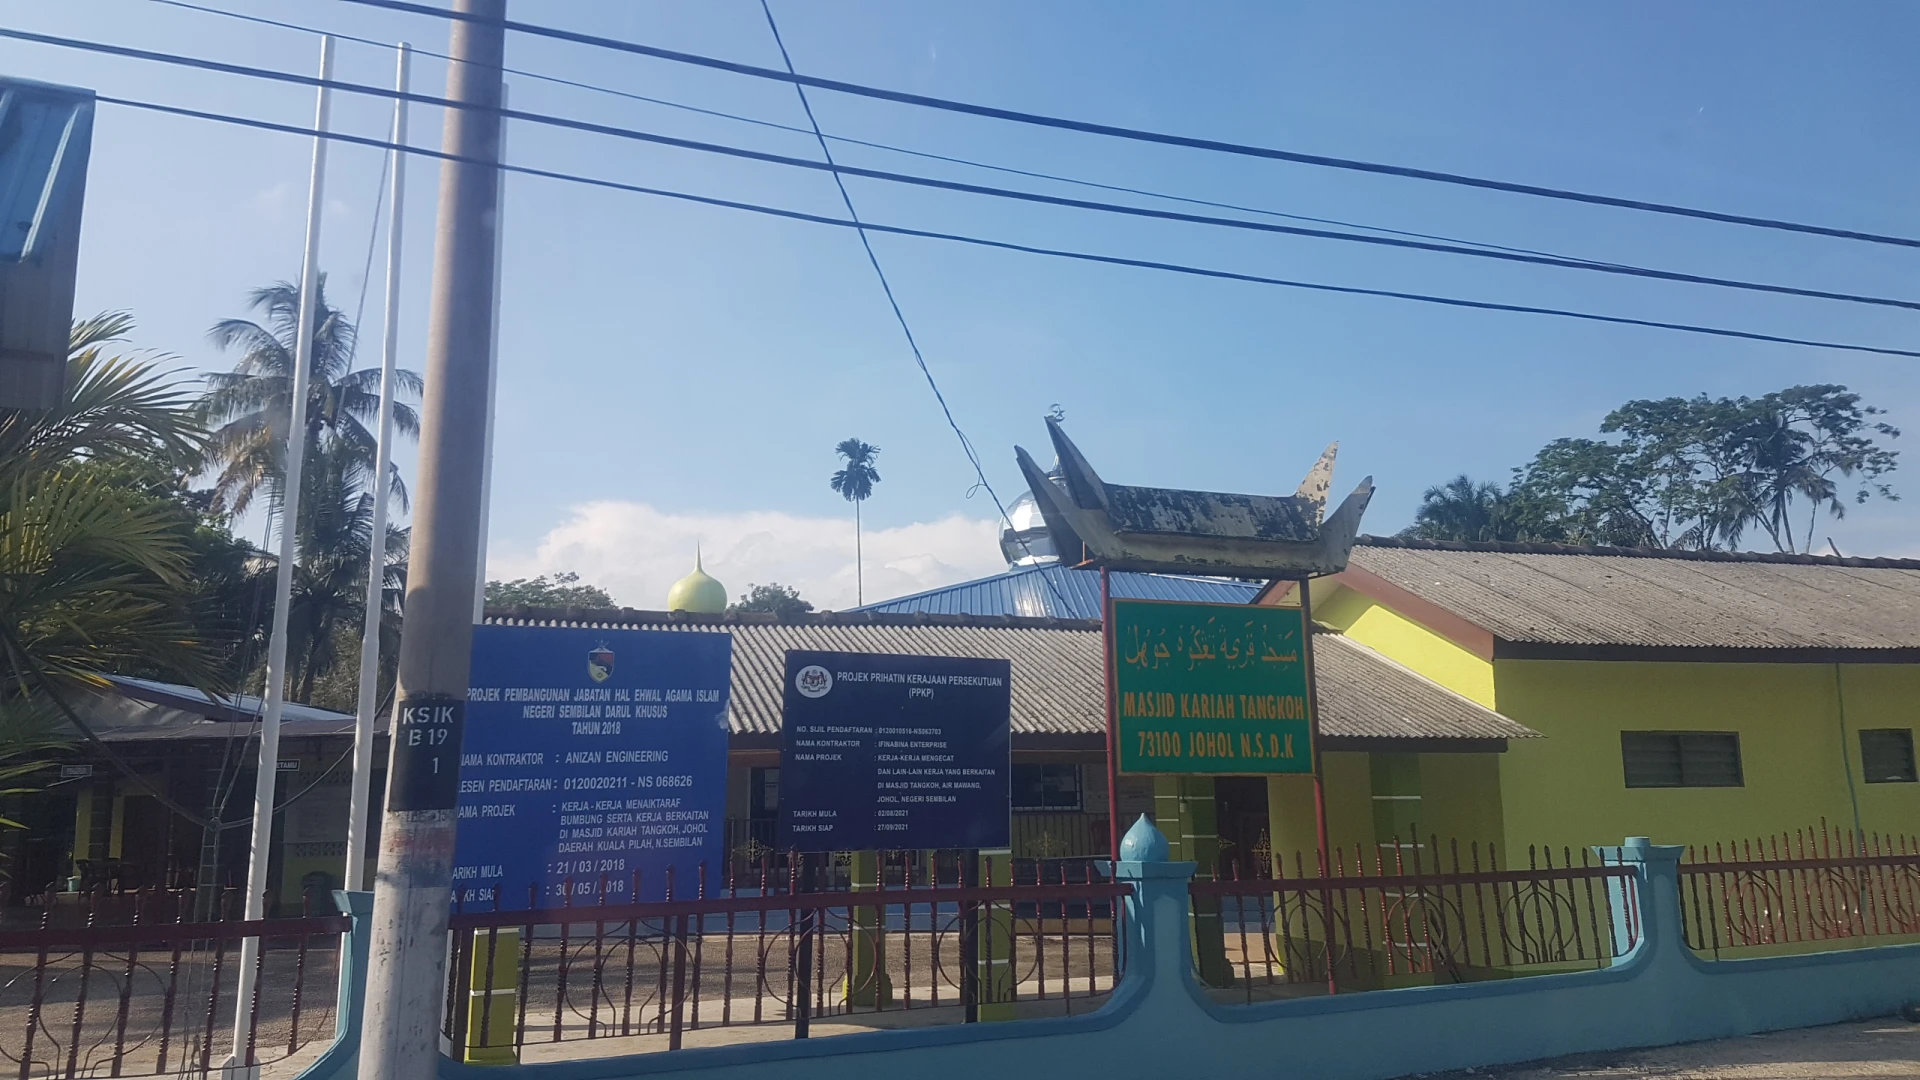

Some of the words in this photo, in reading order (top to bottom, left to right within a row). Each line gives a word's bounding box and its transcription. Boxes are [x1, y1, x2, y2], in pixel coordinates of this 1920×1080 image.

[837, 671, 869, 682] PROJEK
[870, 672, 905, 683] PRIHATIN
[907, 674, 947, 685] KERAJAAN
[949, 675, 1002, 687] PERSEKUTUAN
[504, 688, 570, 701] PEMBANGUNAN
[574, 688, 611, 701] JABATAN
[614, 688, 631, 702] HAL
[634, 689, 661, 702] EHWAL
[665, 690, 693, 702] AGAMA
[696, 690, 720, 702] ISLAM
[908, 688, 934, 700] (PPKP)
[523, 705, 555, 718] NEGERI
[558, 705, 601, 718] SEMBILAN
[605, 705, 631, 718] DARUL
[636, 705, 668, 718] KHUSUS
[1124, 691, 1175, 718] MASJID
[1180, 692, 1235, 719] KARIAH
[1240, 694, 1305, 720] TANGKOH
[572, 722, 600, 735] TAHUN
[602, 722, 621, 735] 2018
[1138, 731, 1181, 757] 73100
[1189, 732, 1234, 758] JOHOL
[1240, 732, 1294, 758] N.S.D.K
[487, 753, 544, 765] KONTRAKTOR
[565, 752, 601, 764] ANIZAN
[606, 750, 669, 763] ENGINEERING
[878, 754, 920, 762] KERJA-KERJA
[432, 757, 439, 774] 1
[459, 780, 485, 793] ESEN
[489, 778, 552, 792] PENDAFTARAN
[564, 776, 627, 790] 0120020211
[638, 776, 653, 788] NS
[656, 776, 693, 788] 068626
[457, 806, 478, 818] AMA
[482, 804, 516, 817] PROJEK
[626, 798, 681, 809] MENAIKTARAF
[560, 814, 603, 826] BUMBUNG
[606, 813, 633, 824] SERTA
[636, 812, 662, 822] KERJA
[666, 811, 709, 821] BERKAITAN
[560, 830, 568, 839] DI
[572, 828, 603, 838] MASJID
[606, 826, 637, 836] KARIAH
[682, 824, 708, 834] JOHOL
[558, 842, 594, 853] DAERAH
[598, 841, 625, 851] KUALA
[452, 866, 478, 880] ARIKH
[481, 865, 503, 878] MULA
